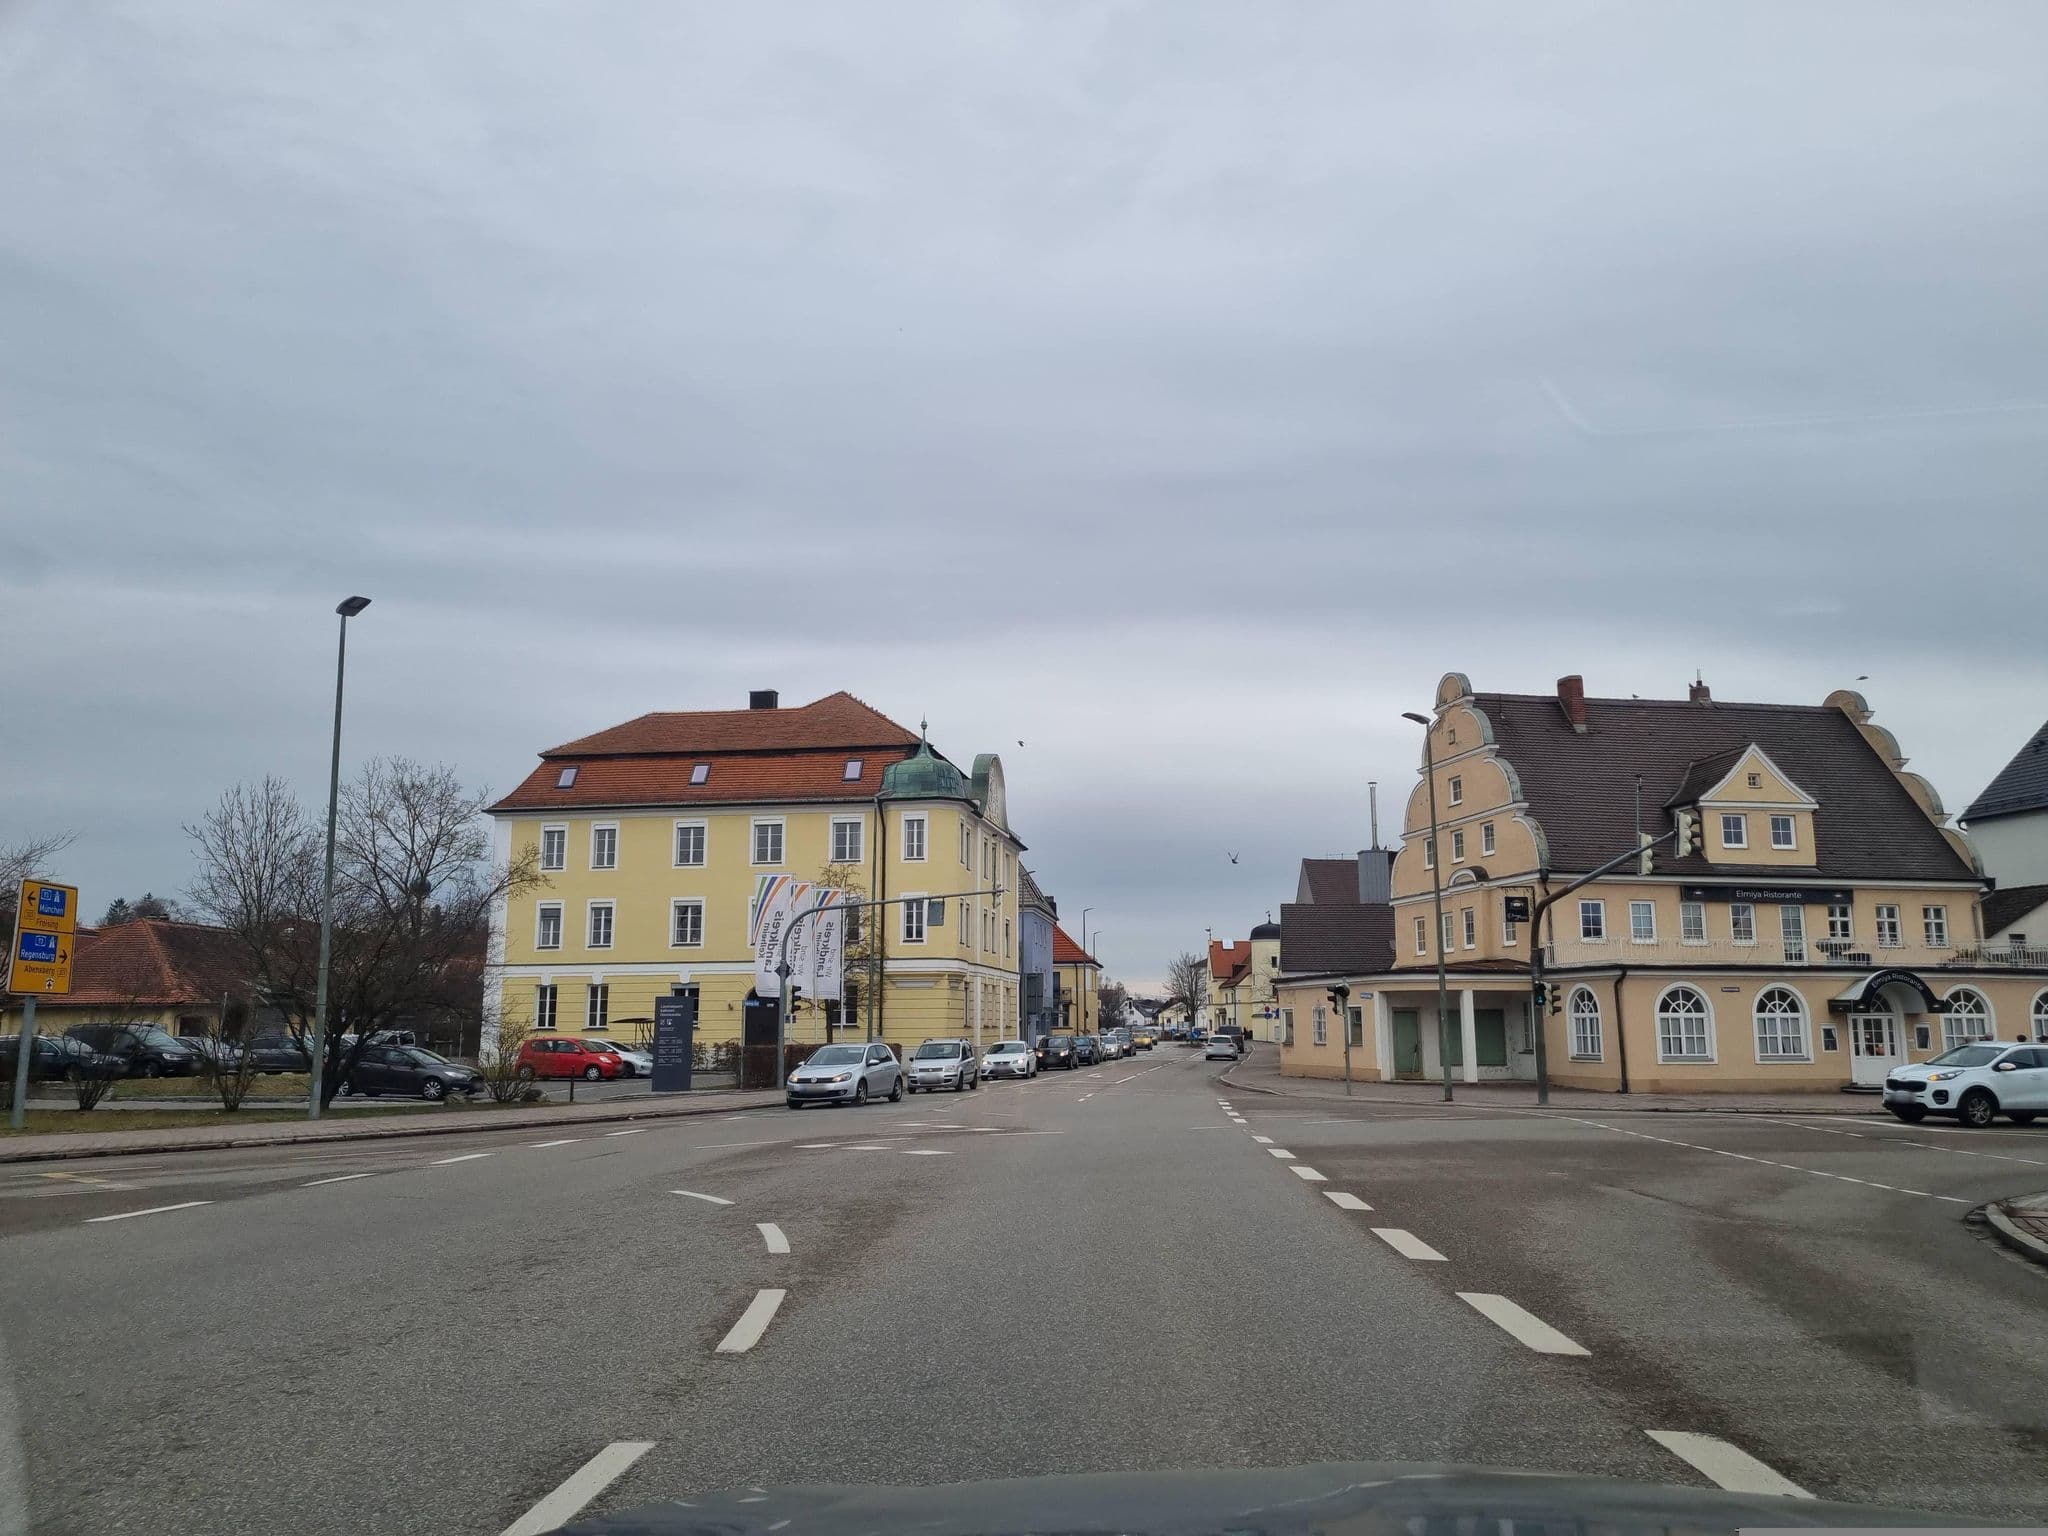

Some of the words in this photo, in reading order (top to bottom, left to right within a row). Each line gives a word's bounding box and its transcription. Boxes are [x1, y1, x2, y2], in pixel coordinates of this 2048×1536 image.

[1736, 890, 1762, 899] Elmiya
[1763, 891, 1803, 899] Ristorante
[39, 903, 65, 915] München
[36, 918, 59, 930] Freising
[20, 948, 56, 962] Regensburg
[24, 965, 57, 976] Abensberg
[1892, 972, 1924, 991] Ristorante
